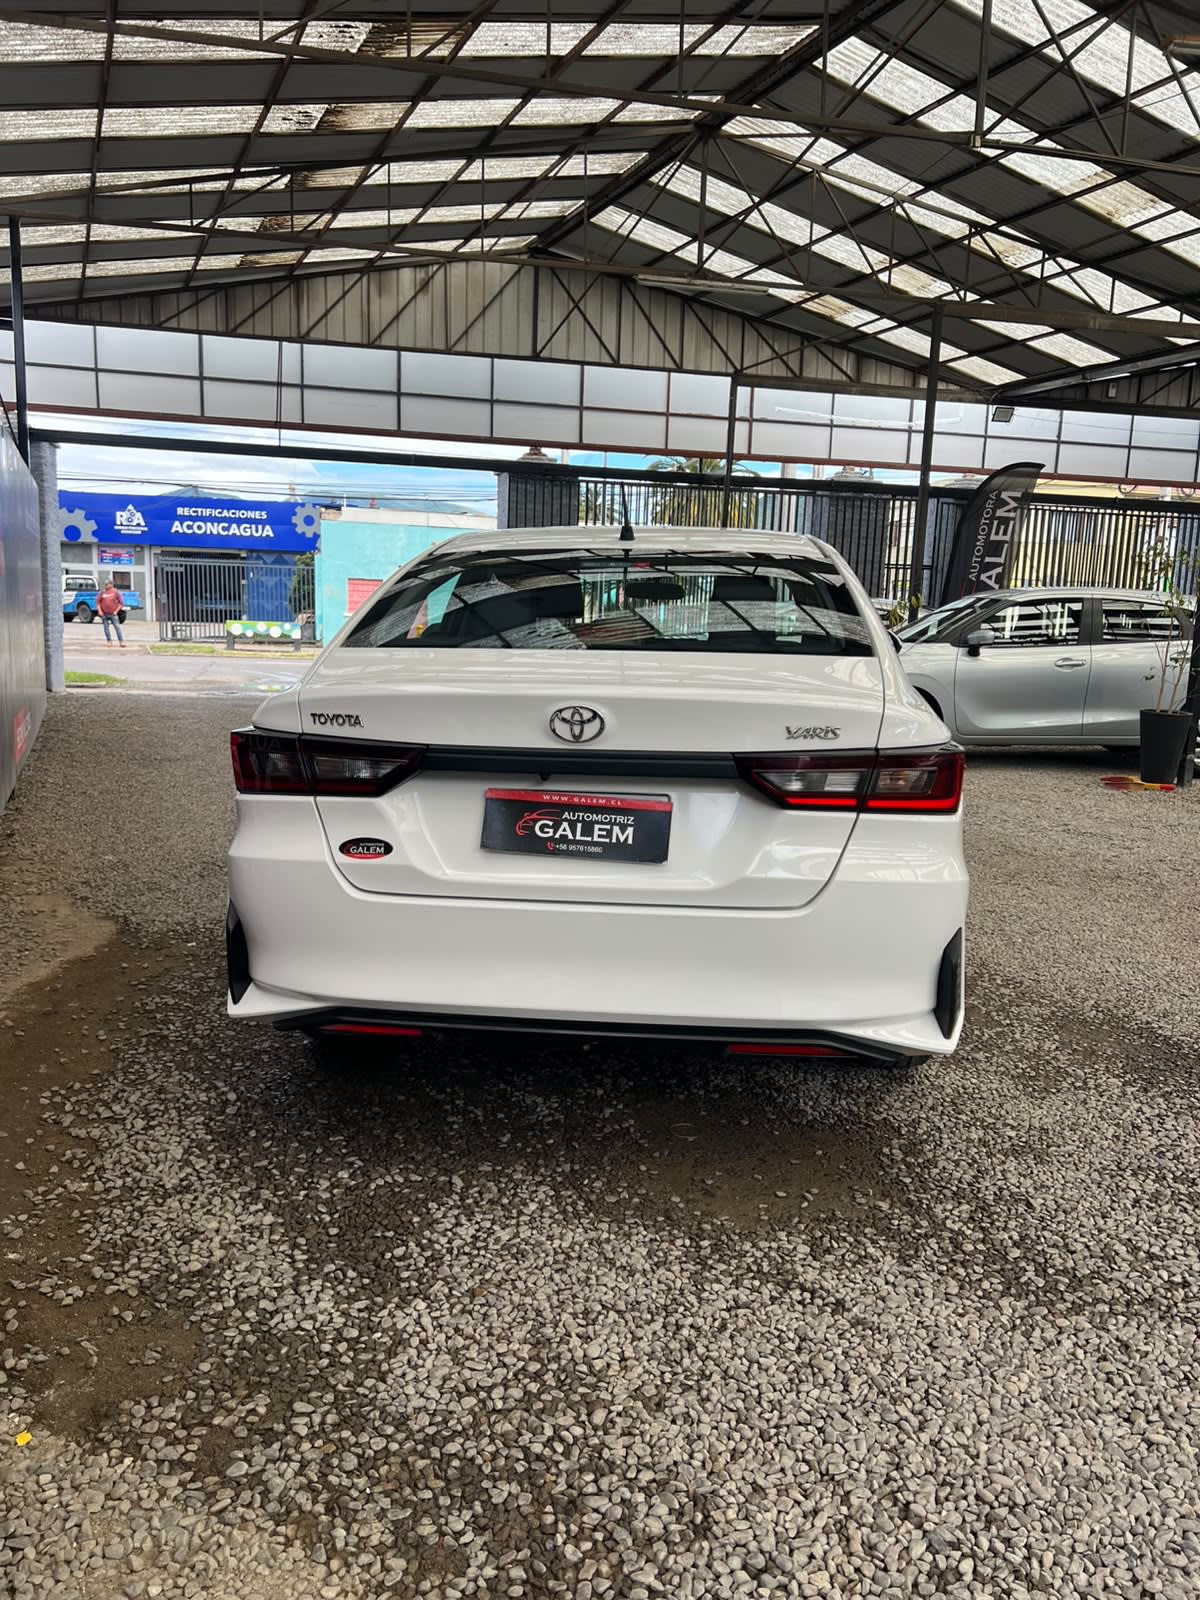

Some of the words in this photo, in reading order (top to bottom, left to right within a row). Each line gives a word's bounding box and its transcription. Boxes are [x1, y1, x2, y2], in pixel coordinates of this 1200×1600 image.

[176, 506, 268, 520] RECTIFICACIONES
[170, 520, 275, 538] ACONCAGUA
[968, 490, 999, 581] AUTOMOTORA
[980, 490, 1022, 590] ALEM
[310, 712, 365, 728] TOYOTA
[542, 794, 623, 806] WWW.GALEM.CL
[561, 811, 636, 825] AUTOMOTRIZ
[533, 819, 635, 845] GALEM
[350, 846, 385, 854] GALEM
